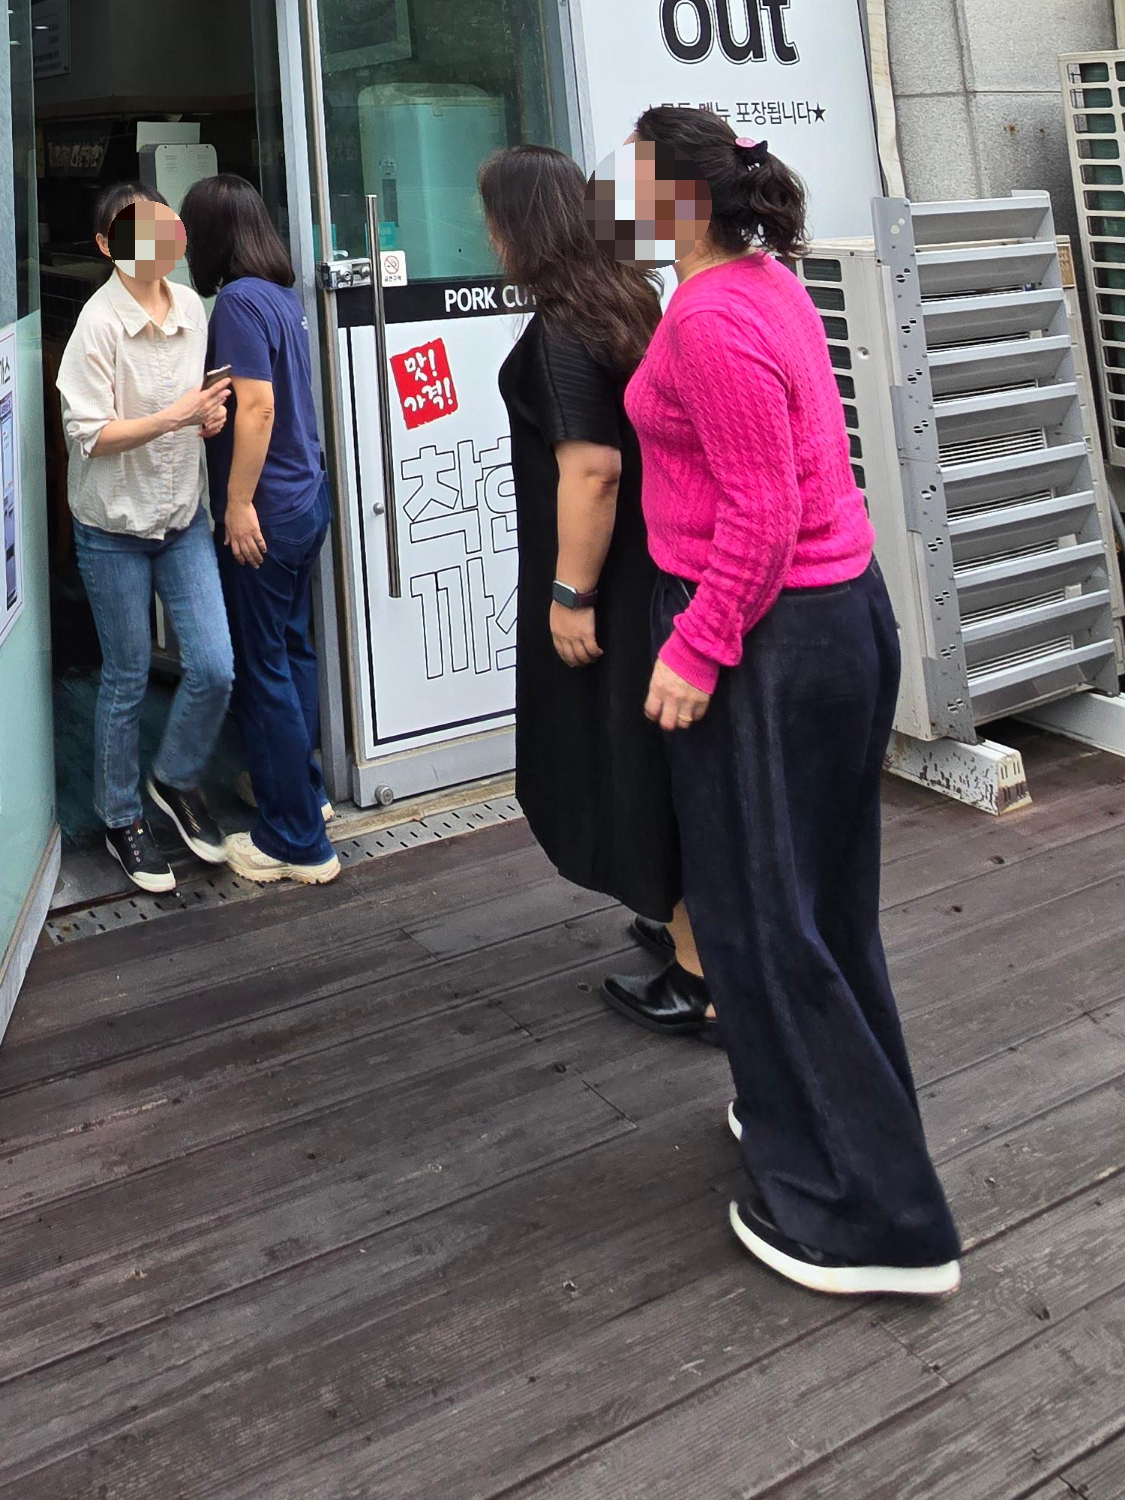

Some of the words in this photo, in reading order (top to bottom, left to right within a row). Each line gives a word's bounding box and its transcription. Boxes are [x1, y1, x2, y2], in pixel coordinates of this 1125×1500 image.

[444, 286, 498, 313] PORK
[404, 348, 438, 382] 맛!
[403, 377, 454, 412] 가격!
